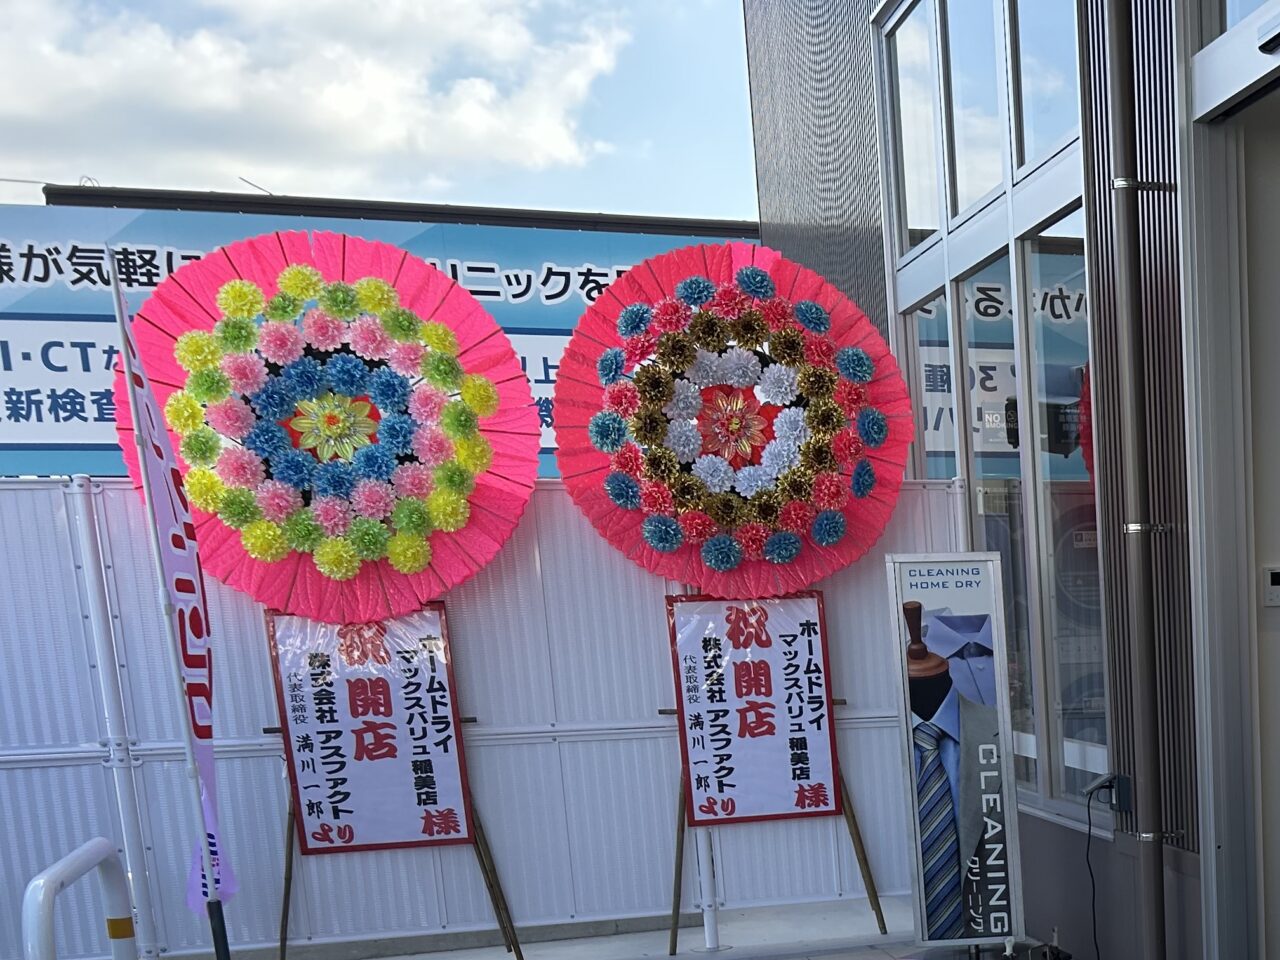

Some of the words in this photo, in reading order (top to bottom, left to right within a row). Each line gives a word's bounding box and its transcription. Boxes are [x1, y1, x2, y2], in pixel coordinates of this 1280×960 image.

[985, 414, 1000, 423] NO
[908, 567, 980, 577] CLEANING
[909, 580, 949, 590] HOME
[955, 579, 981, 588] DRY
[683, 654, 701, 705] 代表取締役
[724, 605, 776, 738] 祝開店
[799, 619, 826, 731] ホームドライ
[286, 671, 309, 725] 代表取締役
[418, 634, 453, 754] ホームドライ
[699, 796, 737, 817] より
[794, 782, 829, 809] 様
[311, 822, 355, 844] より
[420, 808, 461, 837] 様
[978, 743, 1009, 934] CLEANING
[966, 856, 985, 933] クリーニング
